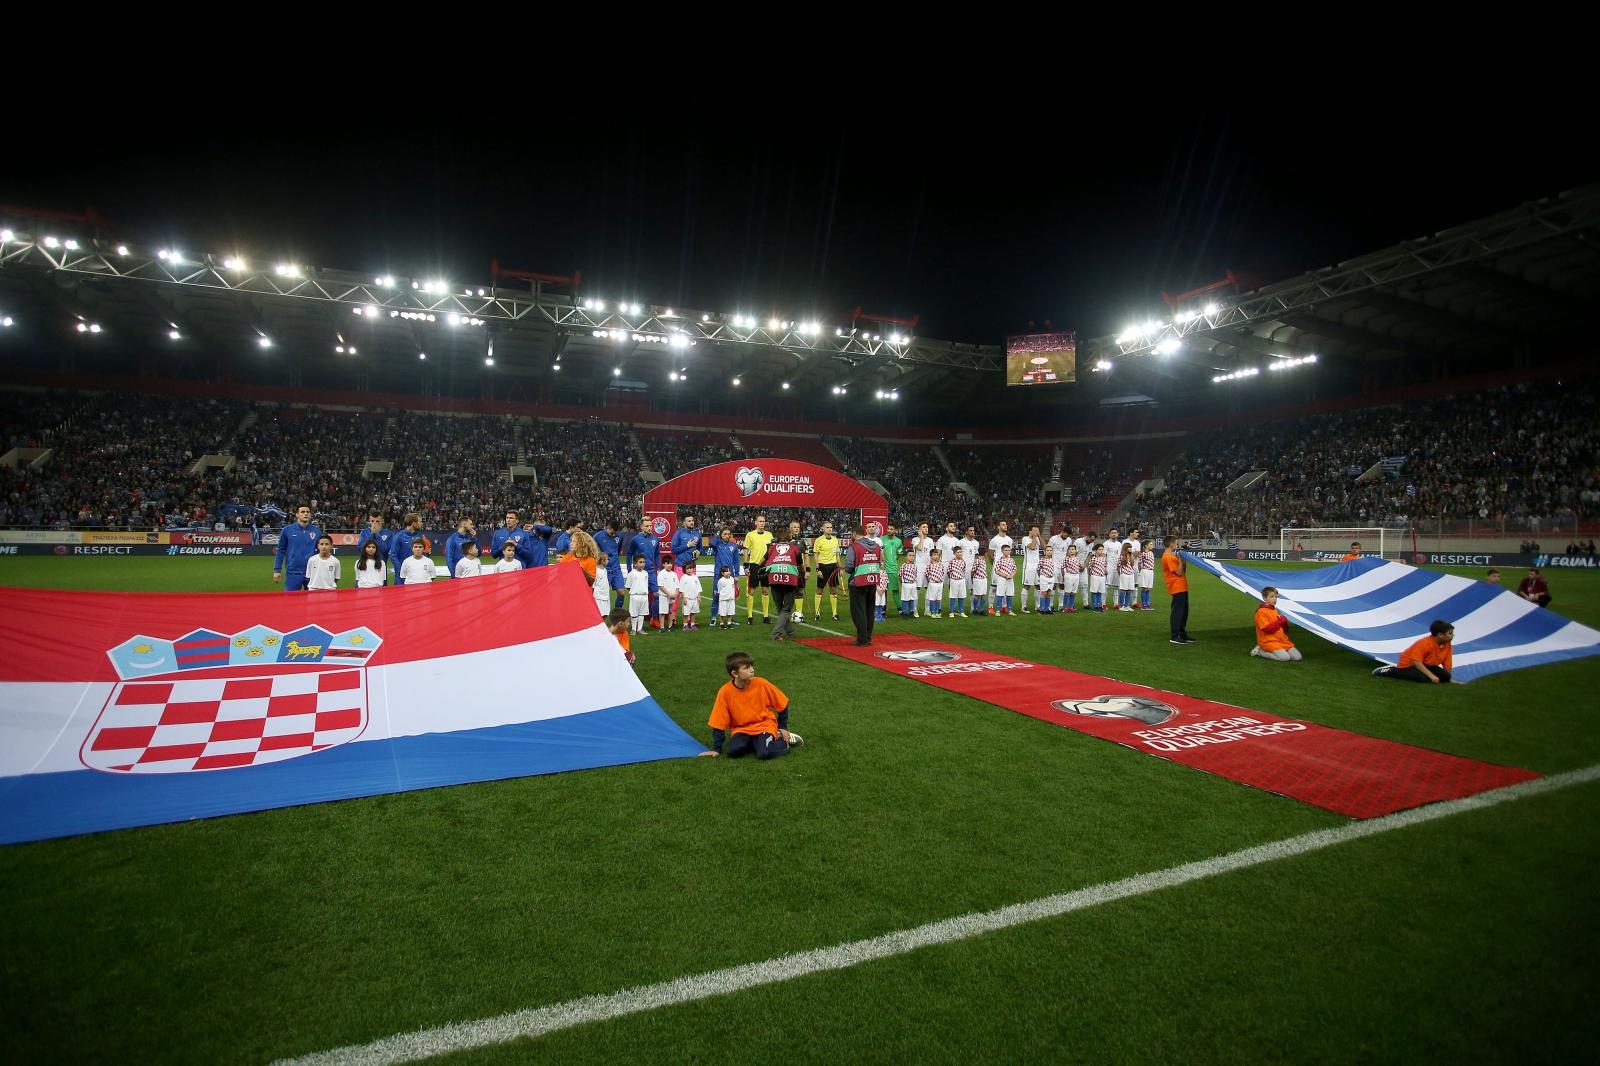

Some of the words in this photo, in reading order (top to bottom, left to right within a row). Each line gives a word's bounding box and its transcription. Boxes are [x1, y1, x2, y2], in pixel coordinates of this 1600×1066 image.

[769, 475, 810, 484] EUROPEAN
[763, 483, 815, 494] QUALIFIERS
[74, 546, 133, 555] RESPECT
[1248, 551, 1289, 560] RESPECT
[1431, 555, 1493, 565] RESPECT
[777, 565, 788, 573] HB
[772, 573, 790, 583] 013
[1131, 716, 1263, 740] EUROPEAN
[1141, 721, 1307, 752] QUALIFIERS
